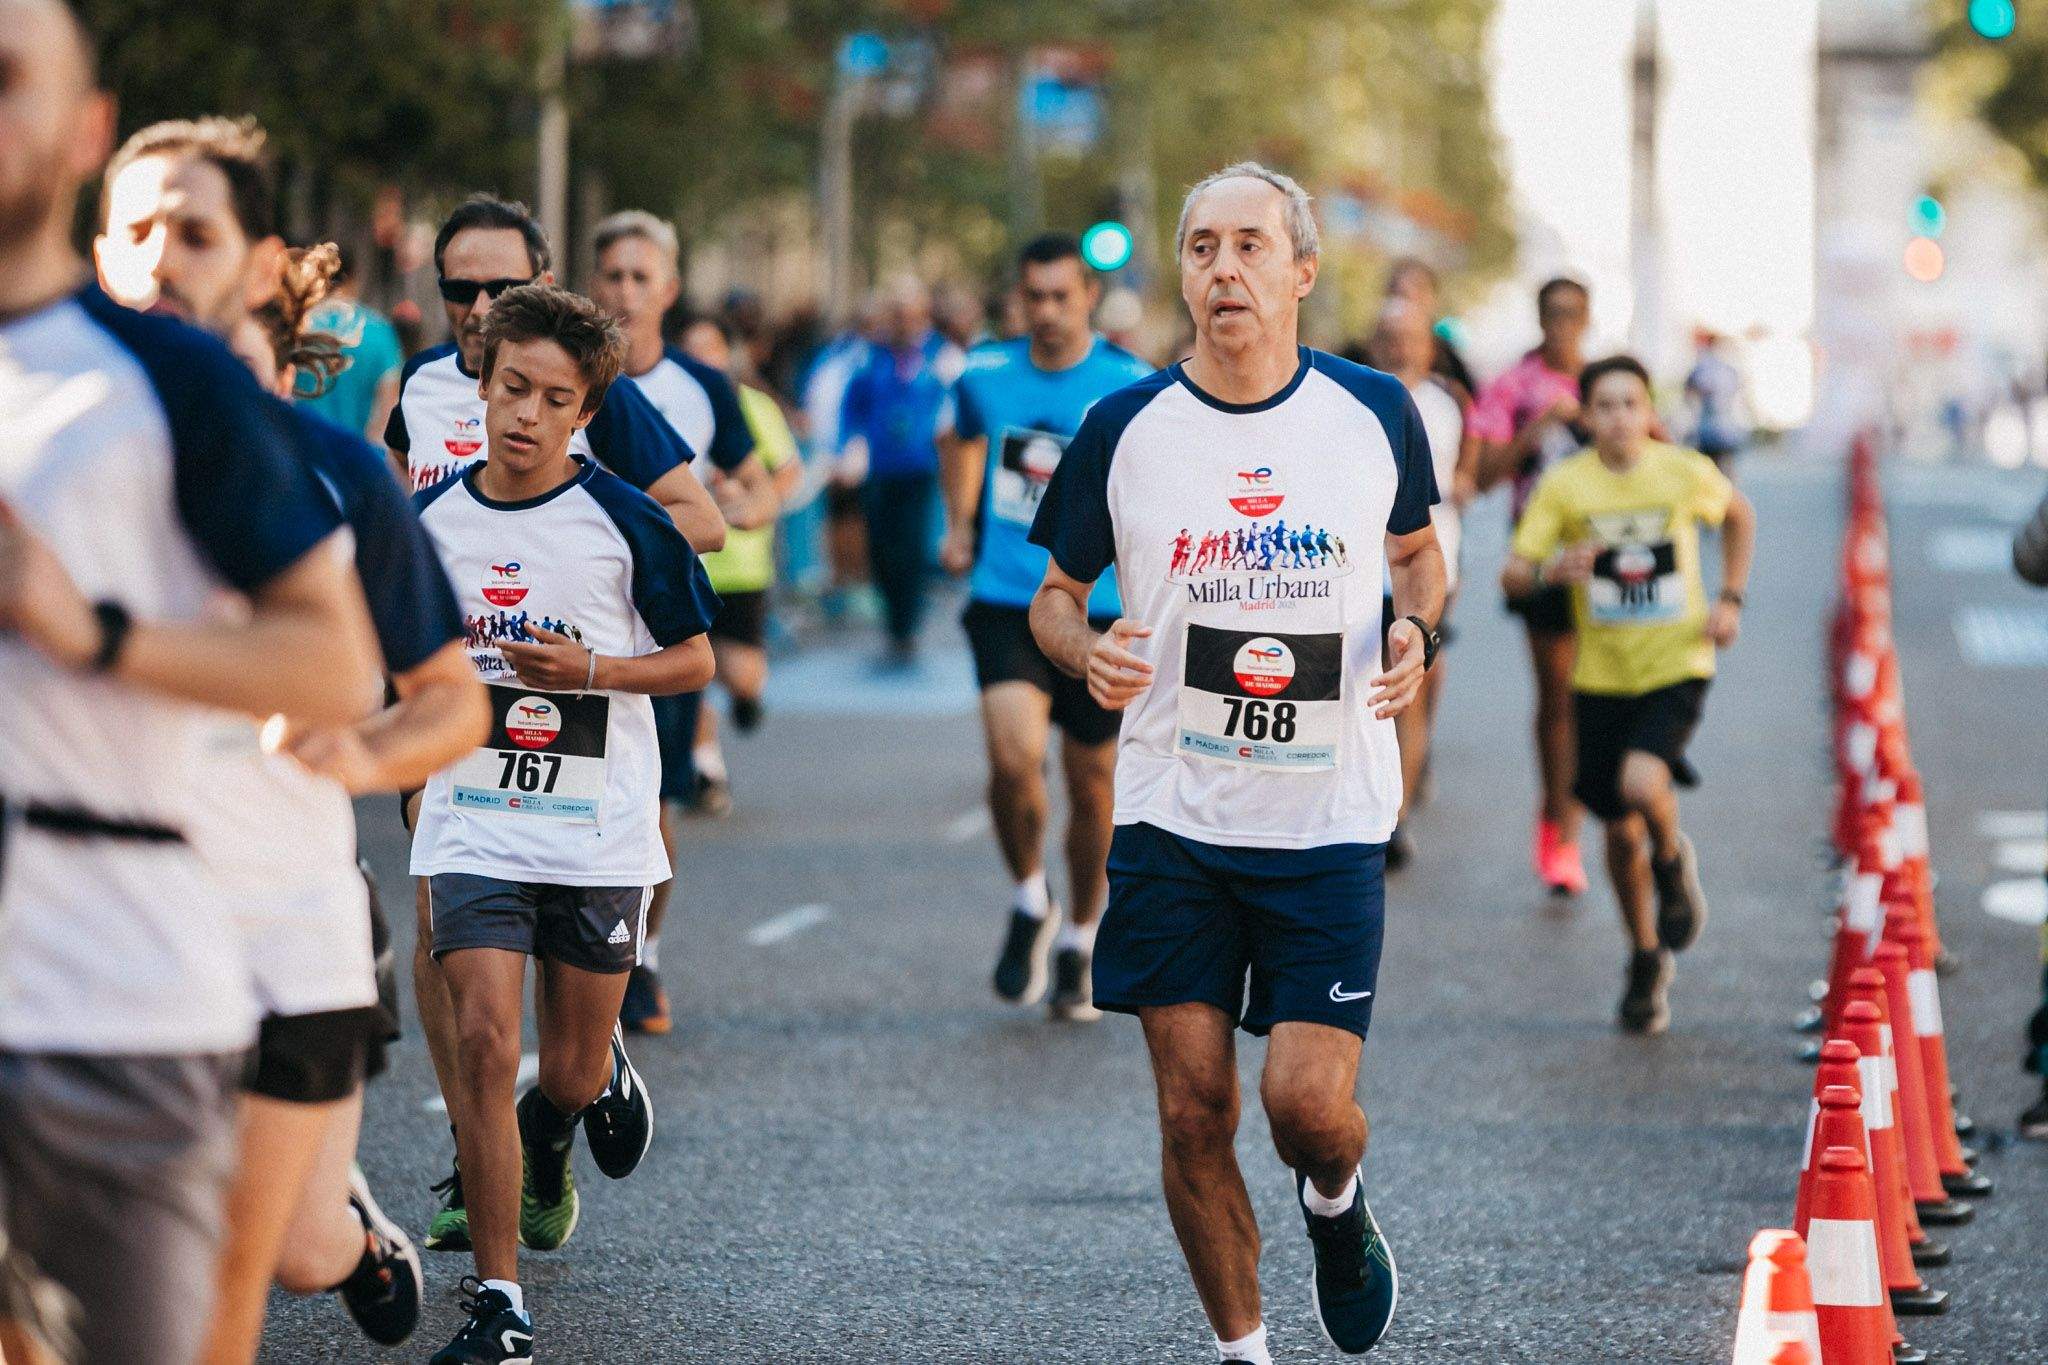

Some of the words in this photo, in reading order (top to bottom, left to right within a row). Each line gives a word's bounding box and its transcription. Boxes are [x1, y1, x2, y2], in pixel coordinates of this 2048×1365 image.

[1188, 579, 1240, 603] Milla
[1249, 574, 1331, 600] Urbana
[1239, 600, 1276, 611] Madrid
[1223, 697, 1297, 743] 768
[1195, 740, 1230, 753] MADRID
[498, 751, 562, 794] 767
[467, 794, 501, 805] MADRID
